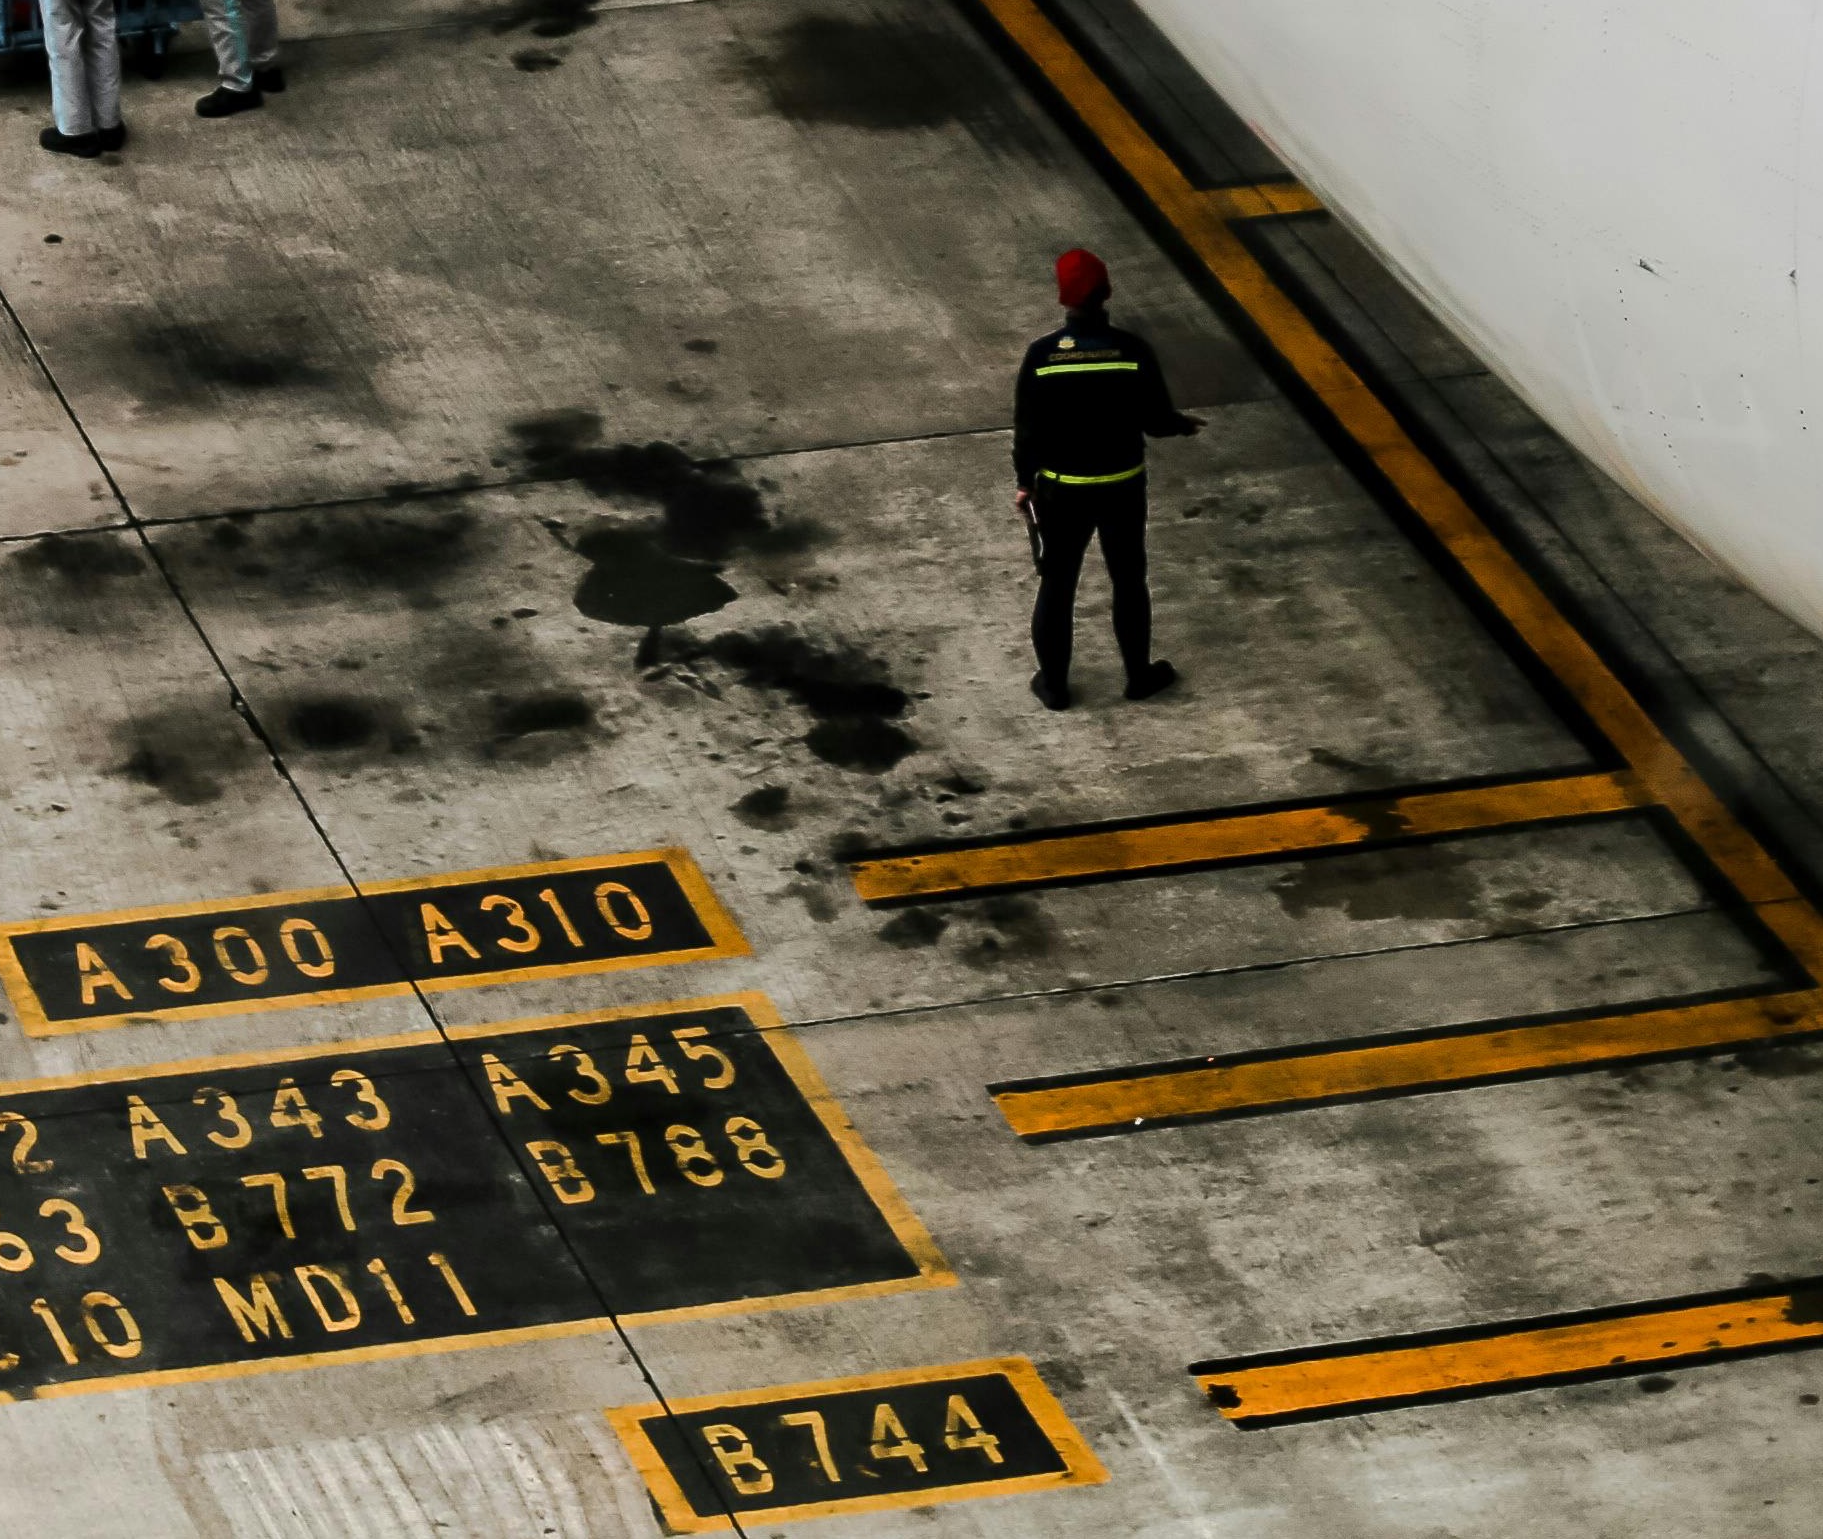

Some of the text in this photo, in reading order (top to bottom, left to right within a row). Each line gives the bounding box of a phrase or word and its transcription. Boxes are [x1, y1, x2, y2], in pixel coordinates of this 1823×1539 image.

[77, 881, 654, 1005] A300 A310
[126, 1069, 391, 1159] A343
[481, 1026, 736, 1115] A345
[162, 1158, 437, 1251] B772
[525, 1116, 787, 1205] B788
[212, 1251, 478, 1343] MD11
[701, 1393, 1006, 1496] B744
